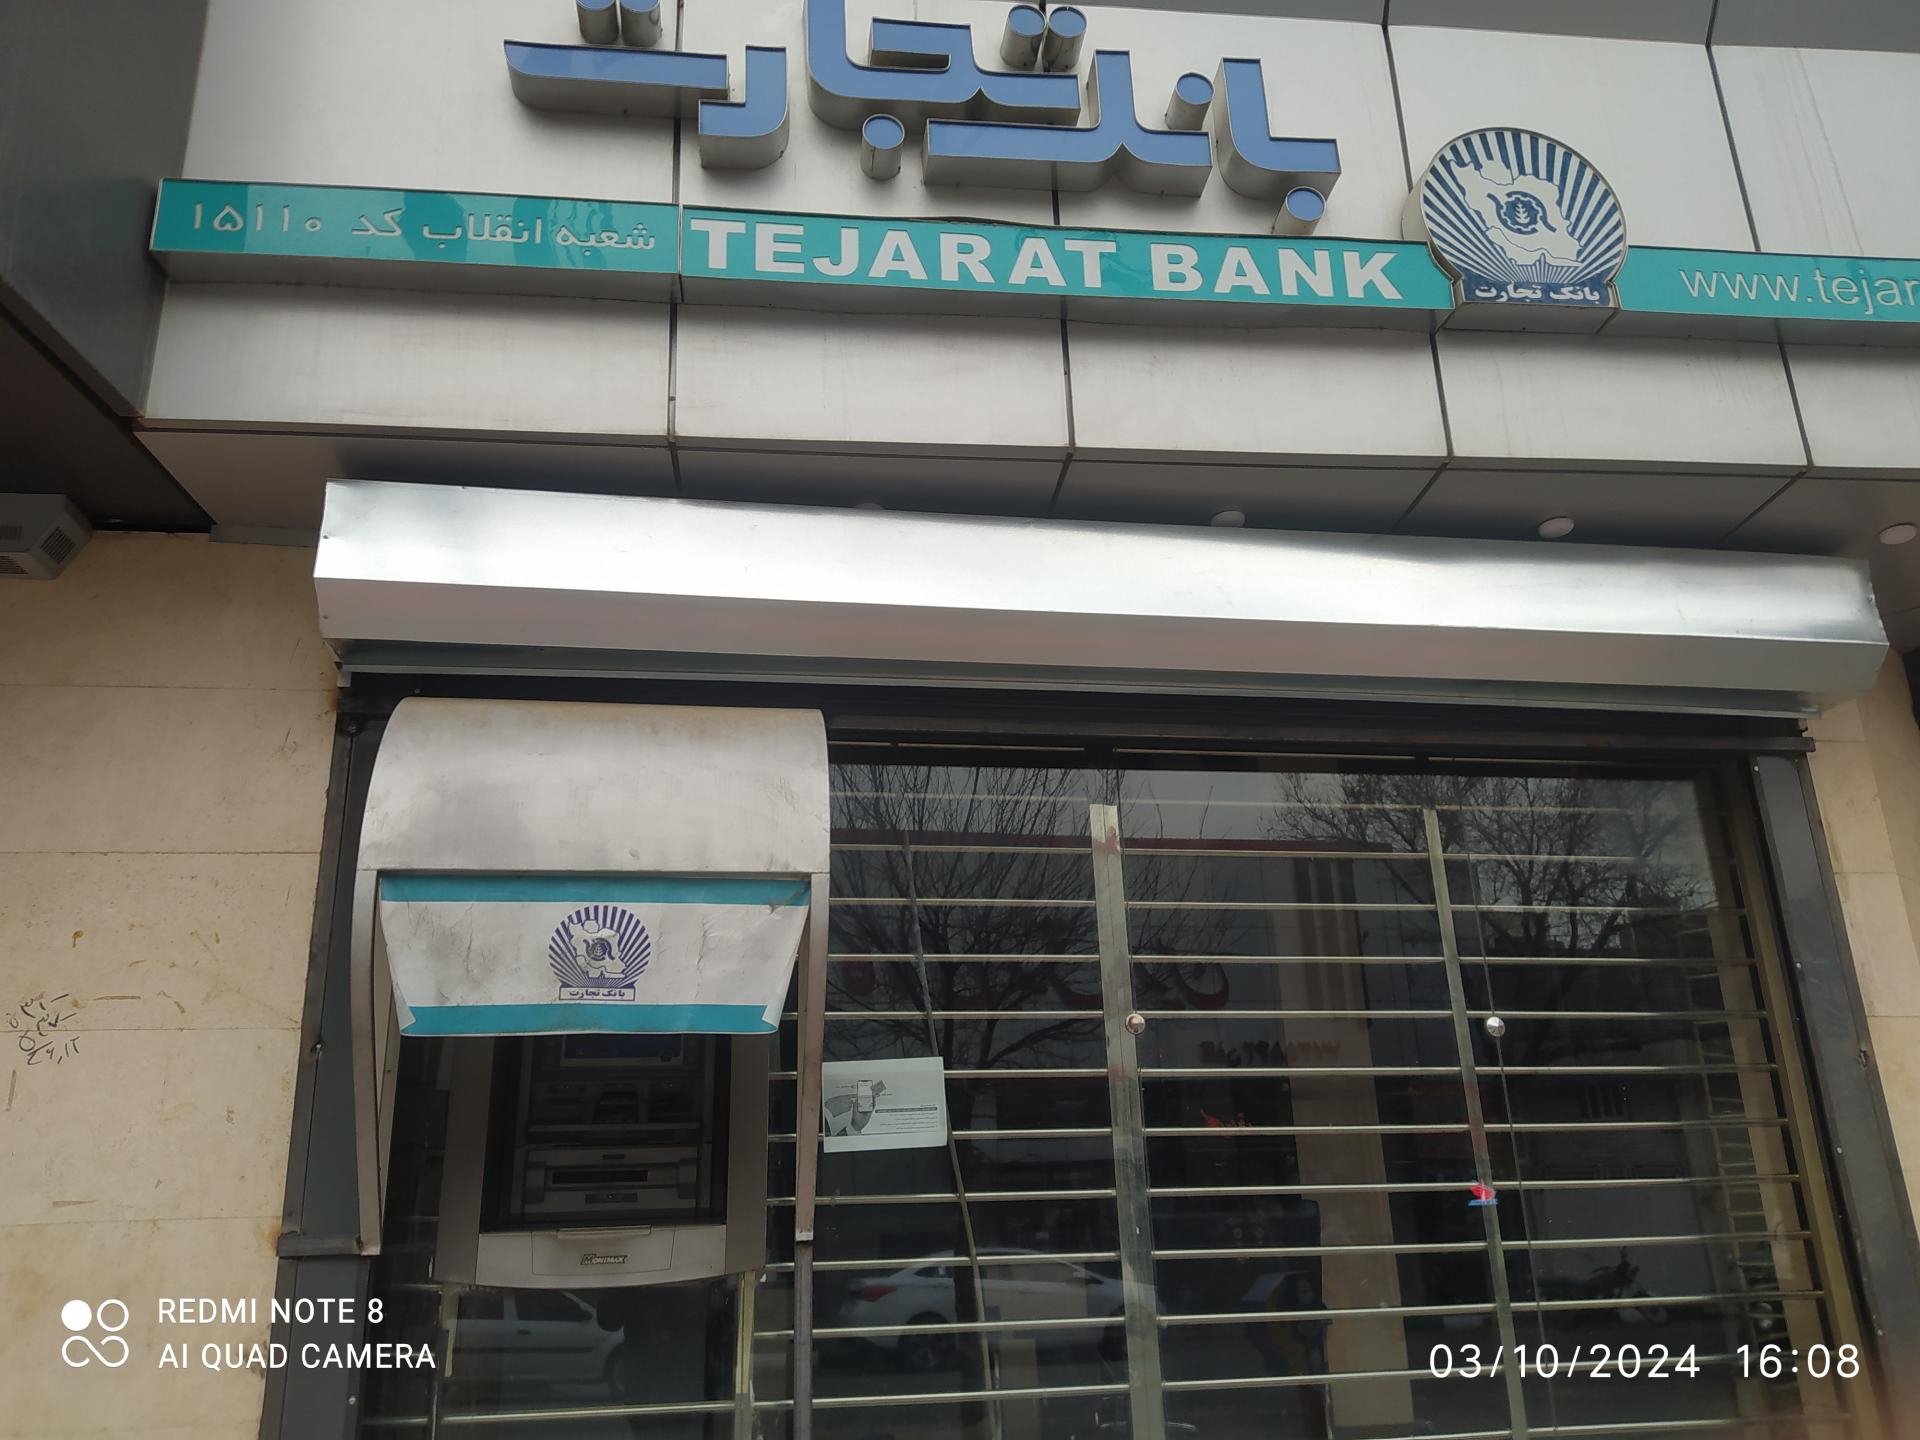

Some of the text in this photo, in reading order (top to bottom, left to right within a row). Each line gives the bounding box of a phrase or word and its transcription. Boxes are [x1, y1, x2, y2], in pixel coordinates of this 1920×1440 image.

[920, 48, 1342, 228] بانک
[350, 207, 403, 237] کد
[422, 214, 543, 251] انقلاب
[555, 222, 656, 257] شعبه
[691, 218, 1403, 300] TEJARAT BANK
[1475, 281, 1600, 304] بانک تجارت
